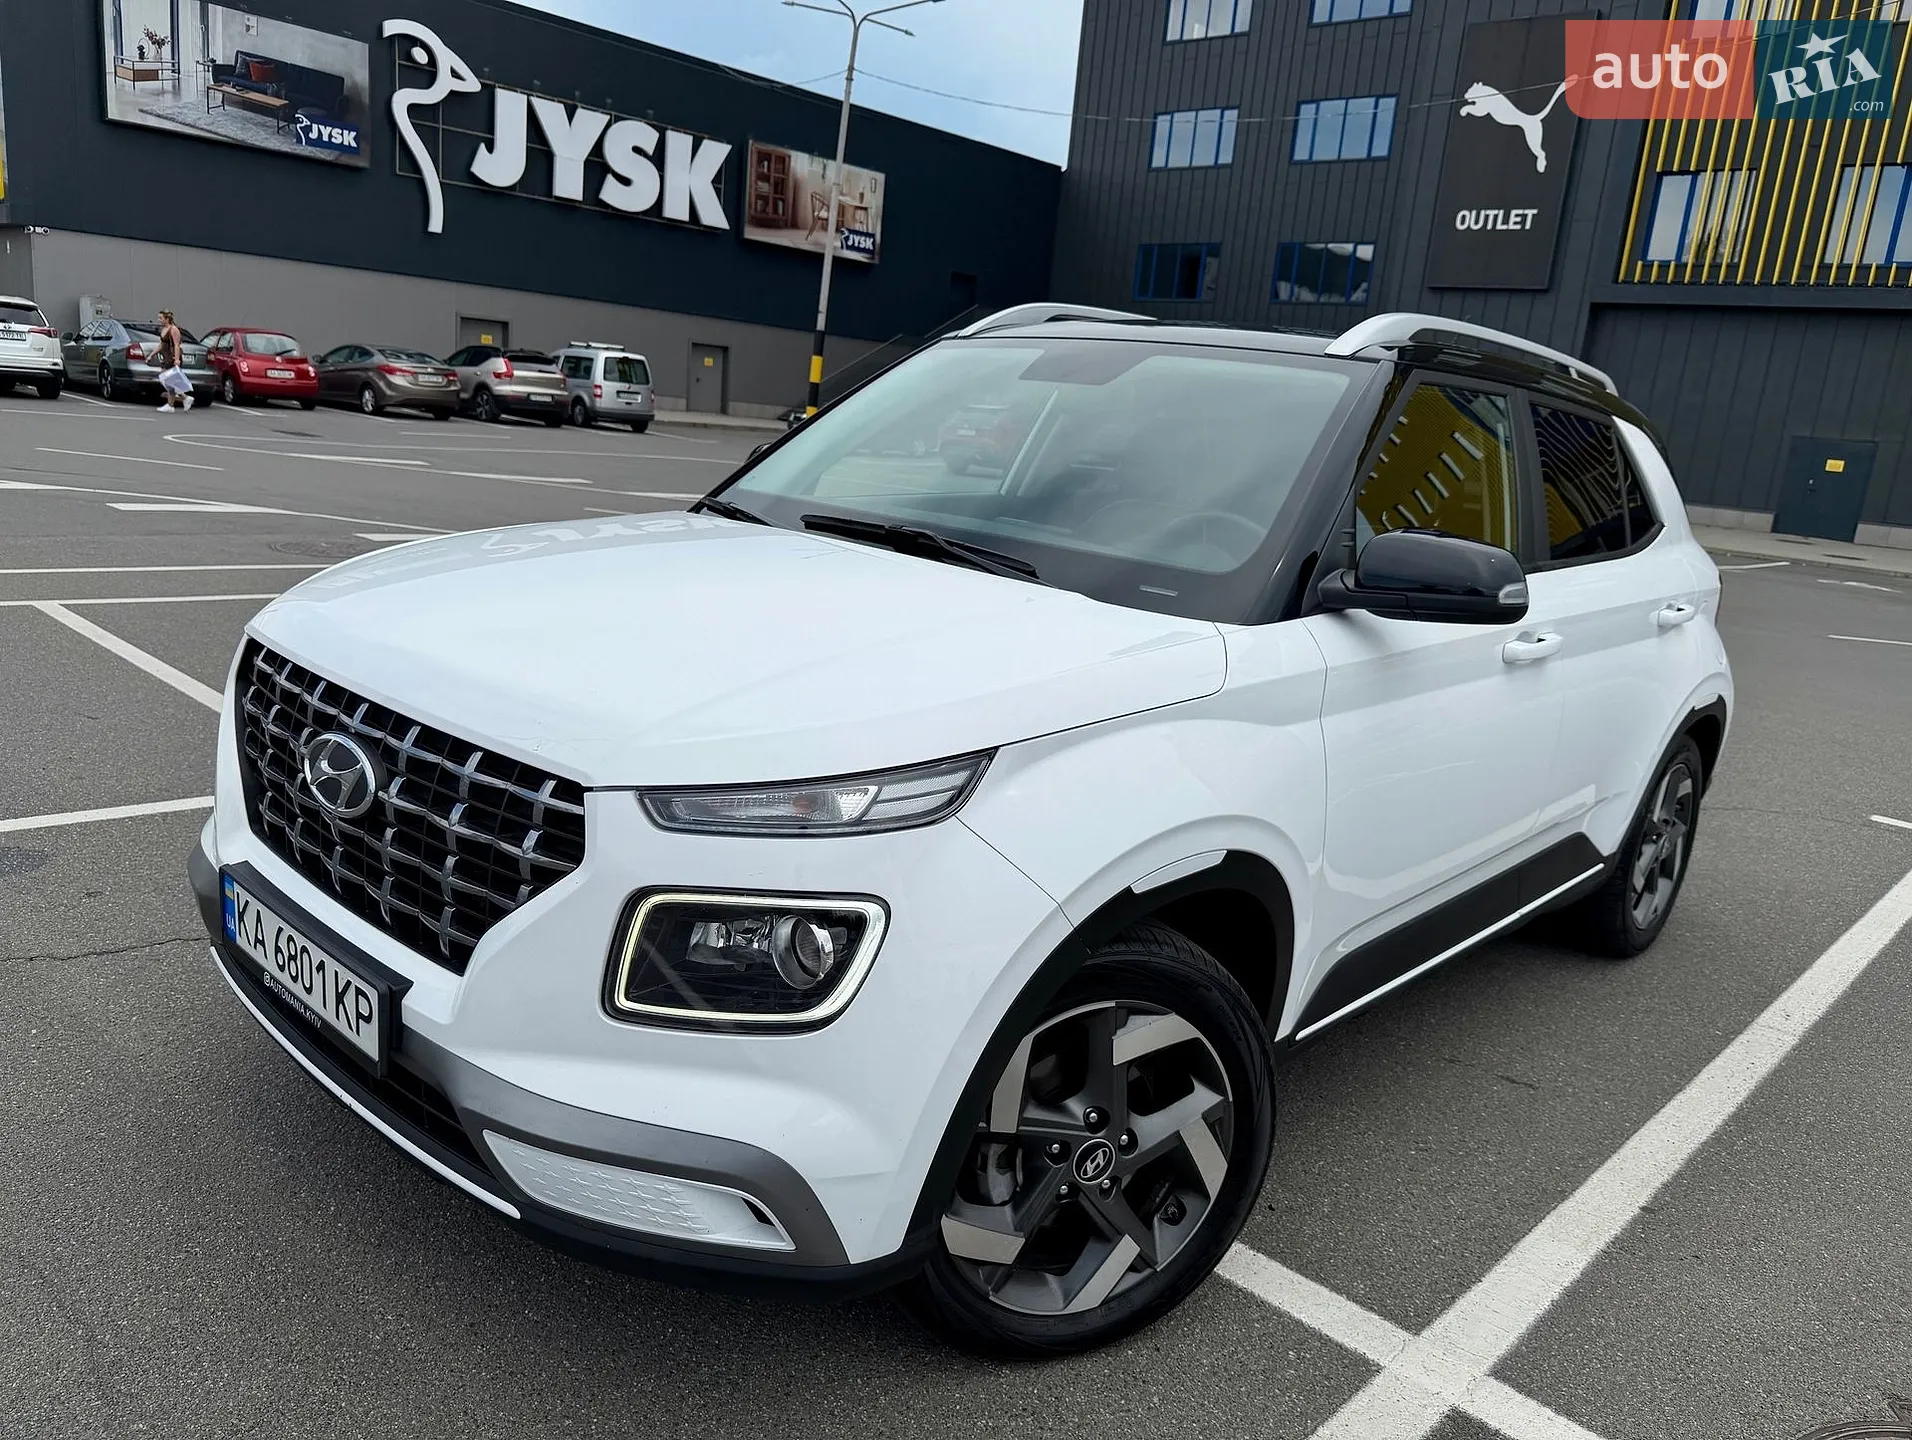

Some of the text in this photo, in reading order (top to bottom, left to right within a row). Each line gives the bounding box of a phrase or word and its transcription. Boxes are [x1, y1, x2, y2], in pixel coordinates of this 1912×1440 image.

[308, 123, 358, 147] JYSK
[470, 88, 732, 230] JYSK
[1455, 208, 1538, 230] OUTLET
[847, 233, 874, 250] JYSK
[226, 913, 236, 933] UA
[236, 891, 268, 960] KA
